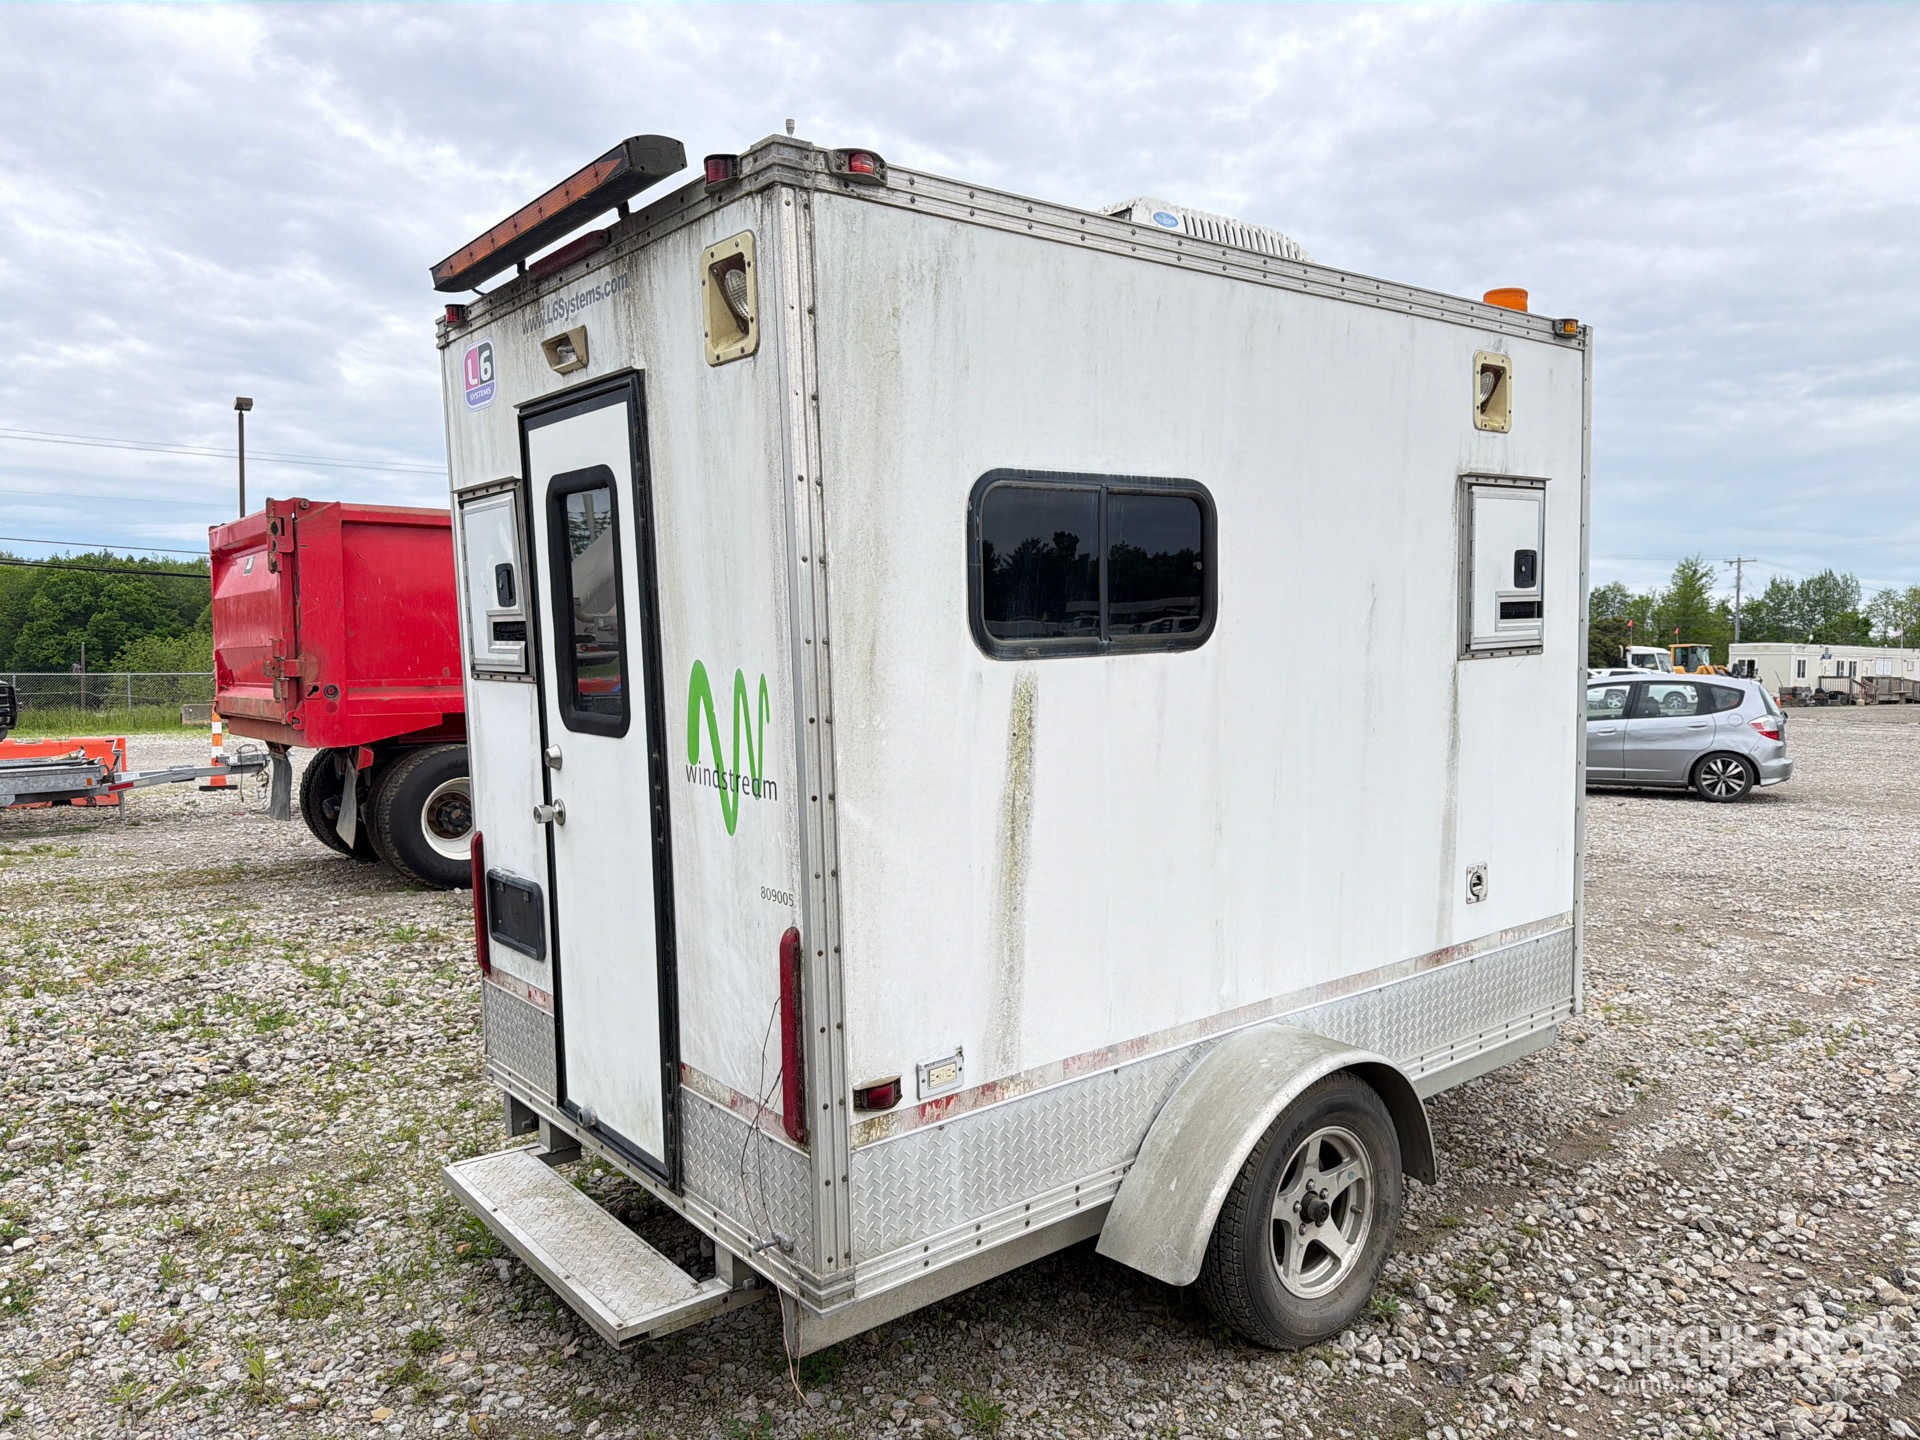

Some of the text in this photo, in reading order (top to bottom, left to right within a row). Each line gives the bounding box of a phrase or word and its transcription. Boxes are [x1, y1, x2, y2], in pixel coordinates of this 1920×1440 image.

[522, 272, 628, 335] www.L6Systems.com
[467, 349, 492, 386] L6
[469, 387, 492, 401] SYSTEMS
[685, 761, 778, 801] windstream
[760, 886, 795, 907] 809005
